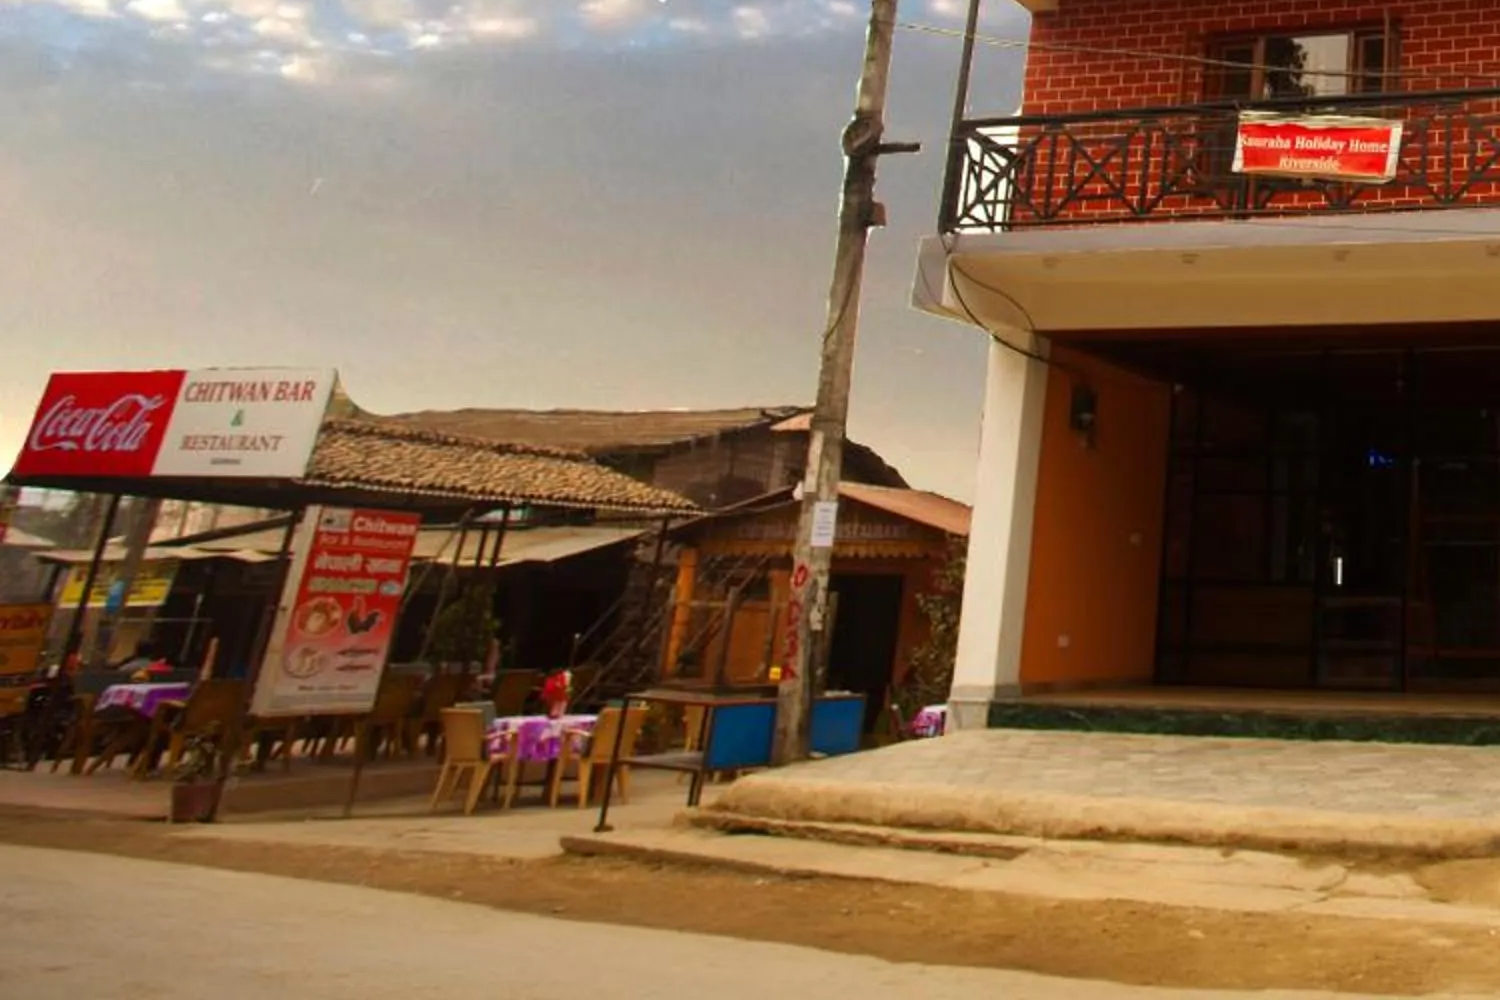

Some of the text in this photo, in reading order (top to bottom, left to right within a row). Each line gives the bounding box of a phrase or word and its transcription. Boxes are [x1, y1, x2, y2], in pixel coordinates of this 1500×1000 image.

[1295, 136, 1346, 154] Holiday
[1279, 156, 1340, 170] Riverside
[184, 381, 317, 403] CHITWAN BAR
[231, 409, 244, 426] &
[180, 435, 286, 452] RESTAURANT
[353, 516, 417, 535] Chitwan
